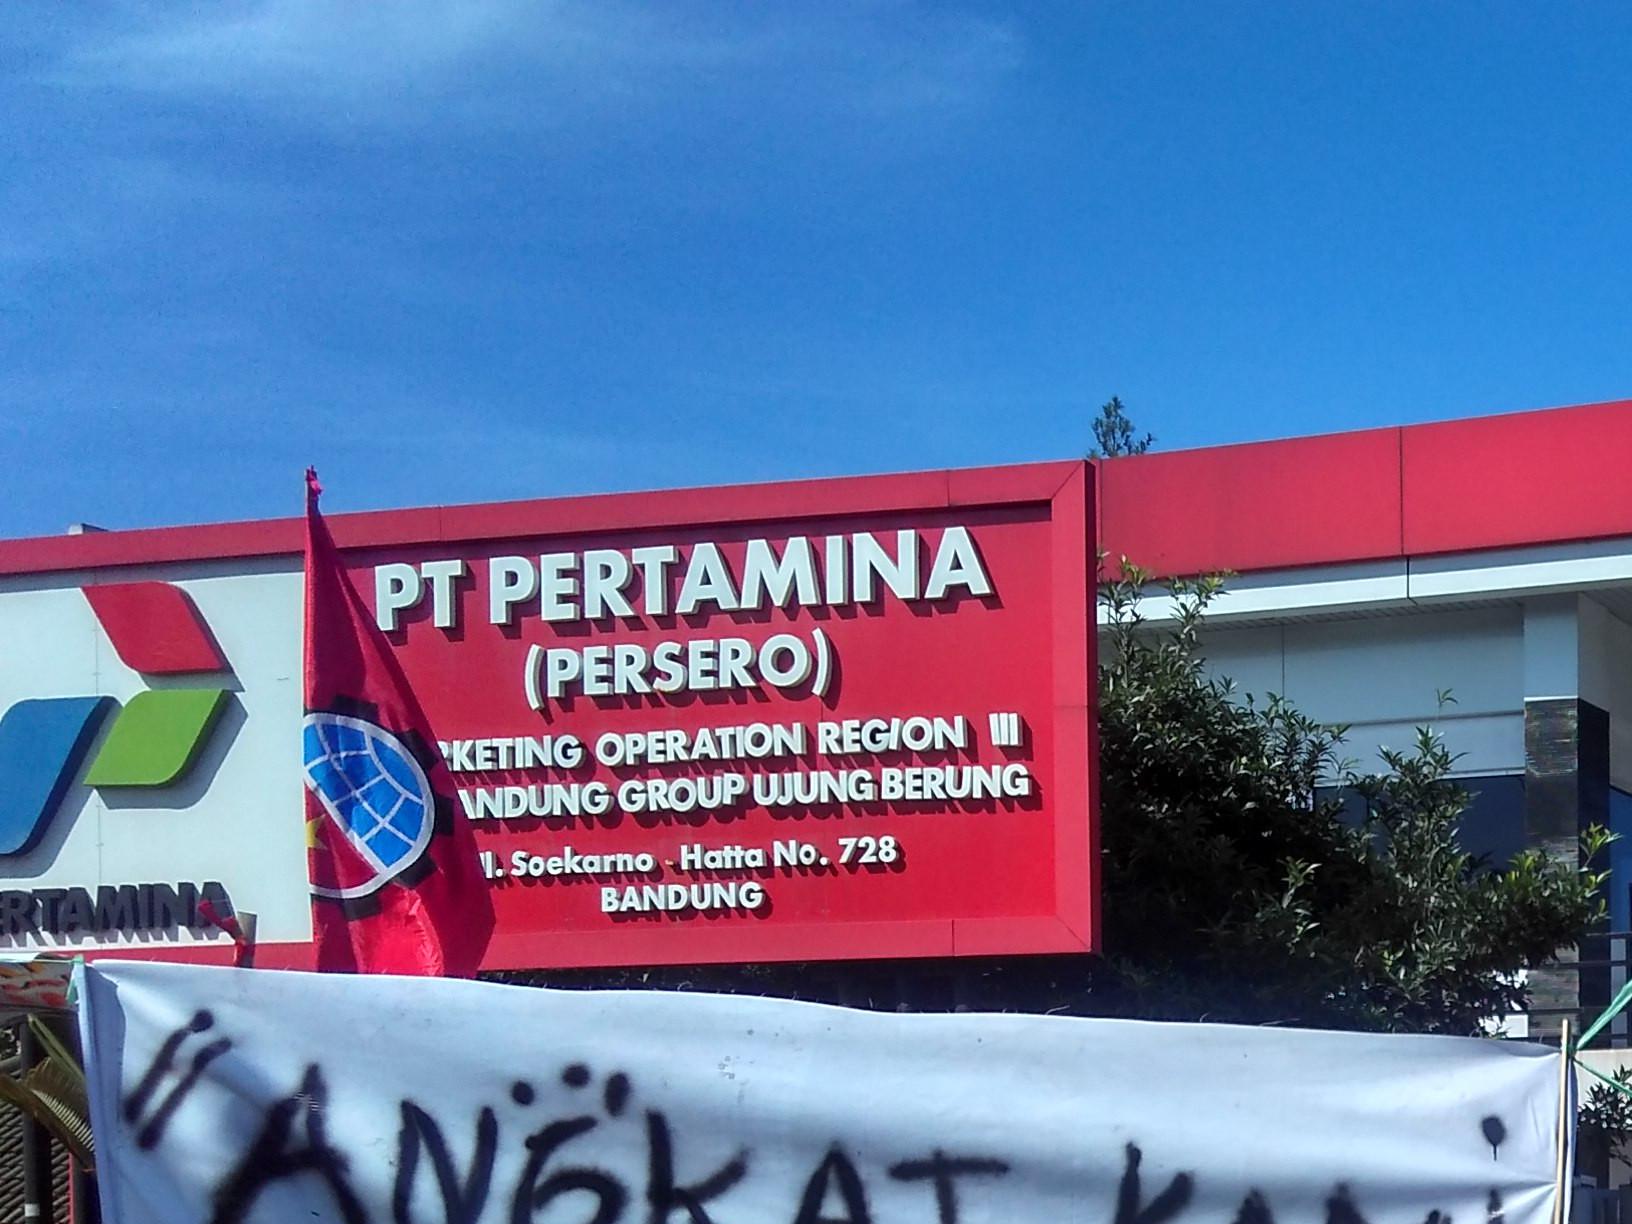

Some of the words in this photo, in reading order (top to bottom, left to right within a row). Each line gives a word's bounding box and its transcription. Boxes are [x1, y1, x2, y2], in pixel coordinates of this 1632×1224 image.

[374, 558, 468, 632] PT
[488, 526, 992, 625] PERTAMINA
[524, 627, 832, 711] (PERSERO)
[436, 734, 583, 772] KETING
[595, 722, 807, 767] OPERATION
[817, 715, 967, 755] REGION
[617, 774, 747, 814] GROUP
[752, 769, 878, 808] UJUNG
[880, 764, 1031, 800] BERUNG
[510, 845, 656, 878] Soekarno
[680, 843, 766, 872] Hatta
[772, 839, 829, 869] No.
[838, 835, 899, 864] 728
[0, 881, 237, 934] RTAMINA
[600, 881, 765, 913] BANDUNG
